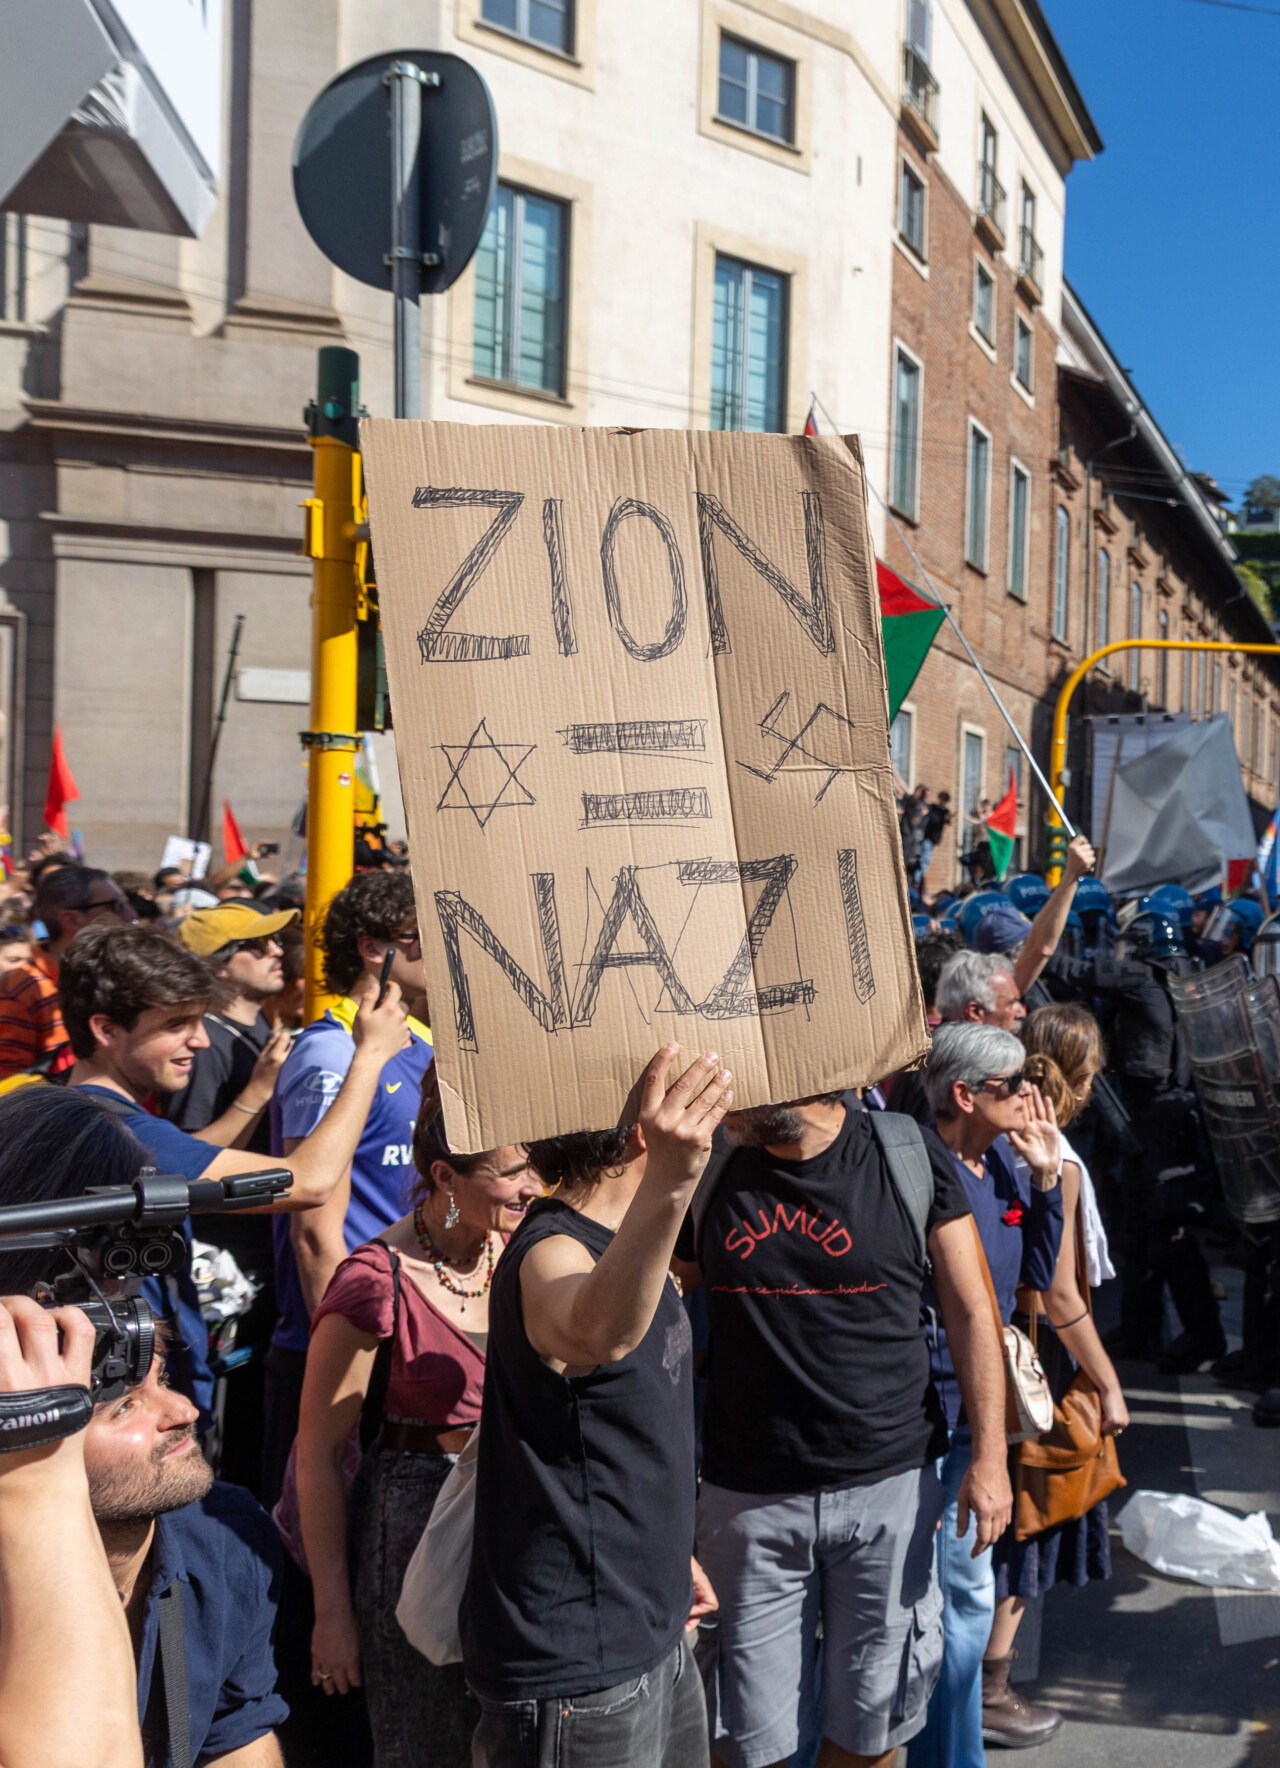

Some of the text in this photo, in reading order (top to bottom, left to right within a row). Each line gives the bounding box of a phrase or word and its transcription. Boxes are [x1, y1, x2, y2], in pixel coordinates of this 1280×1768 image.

[412, 487, 836, 662] ZION
[435, 849, 877, 1054] NAZI
[725, 1203, 852, 1259] SUMUD
[0, 1408, 60, 1430] anon
